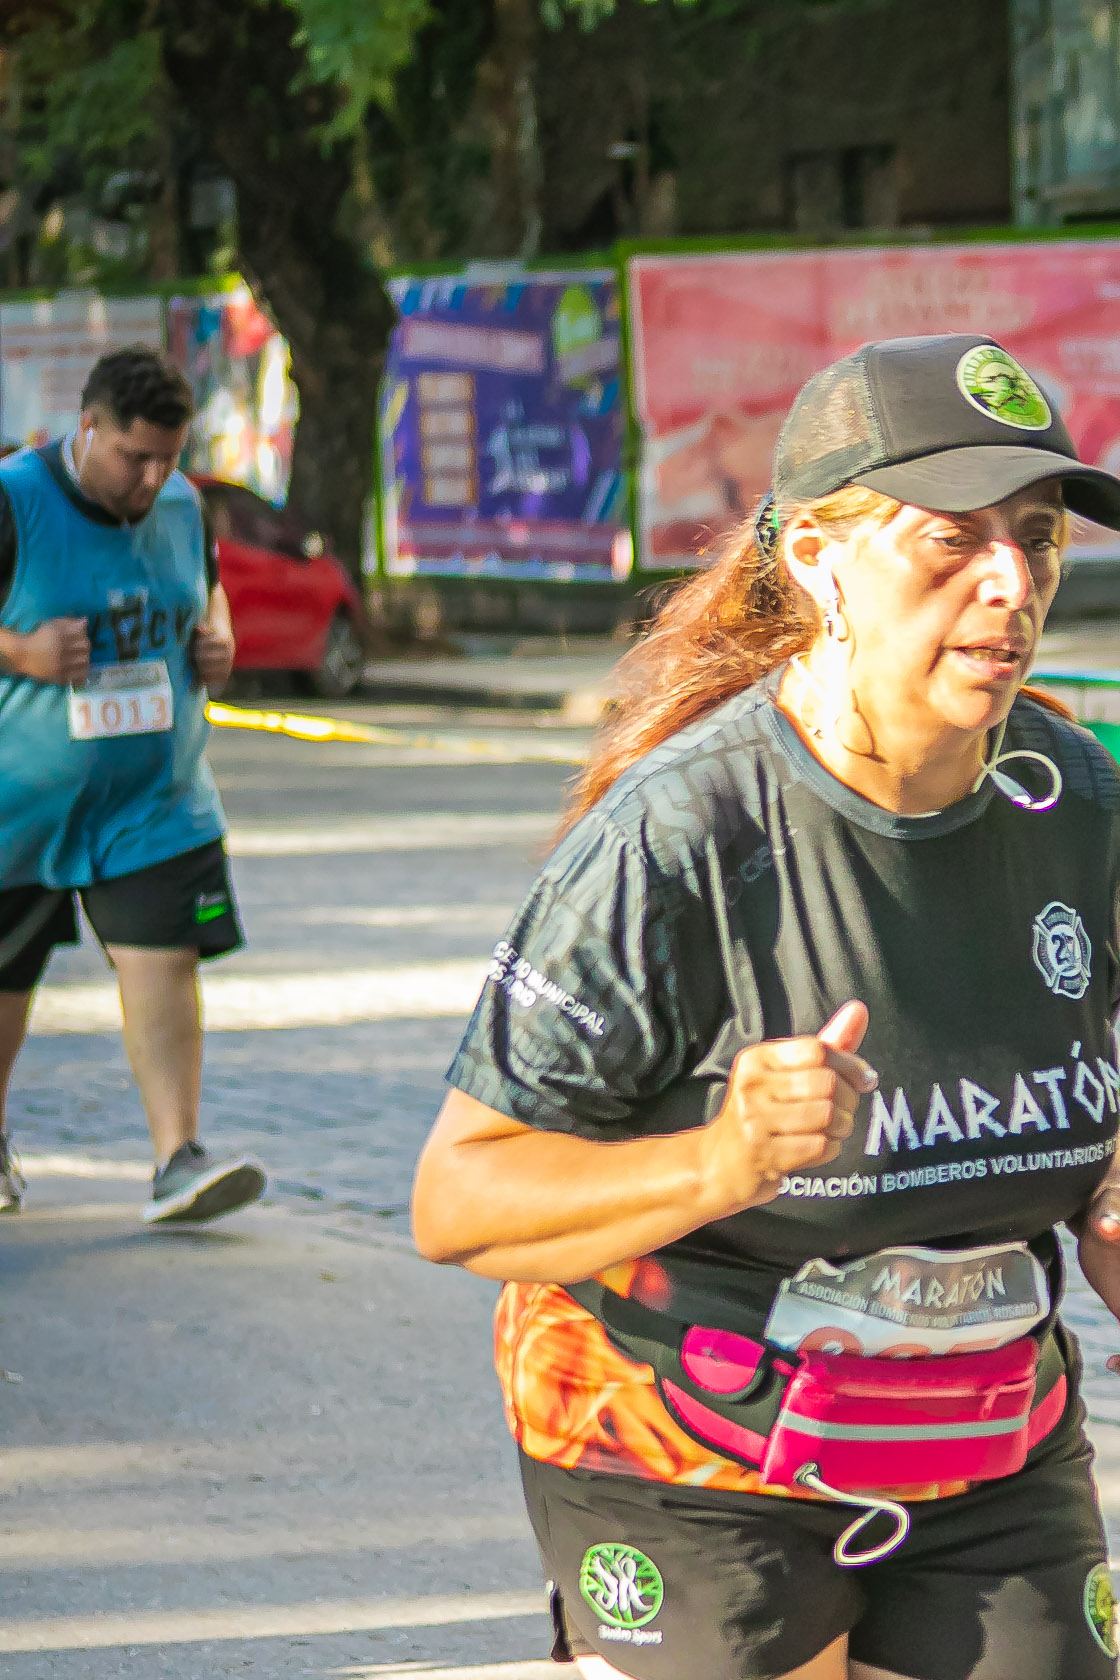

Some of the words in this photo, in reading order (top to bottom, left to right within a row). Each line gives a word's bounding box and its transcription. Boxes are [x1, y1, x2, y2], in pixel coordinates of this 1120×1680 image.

[77, 696, 168, 732] 1013
[524, 968, 605, 1036] MUNICIPAL
[881, 1159, 987, 1193] BOMBEROS
[990, 1142, 1104, 1175] VOLUNTARIOS
[871, 1262, 1007, 1310] MARATÓN
